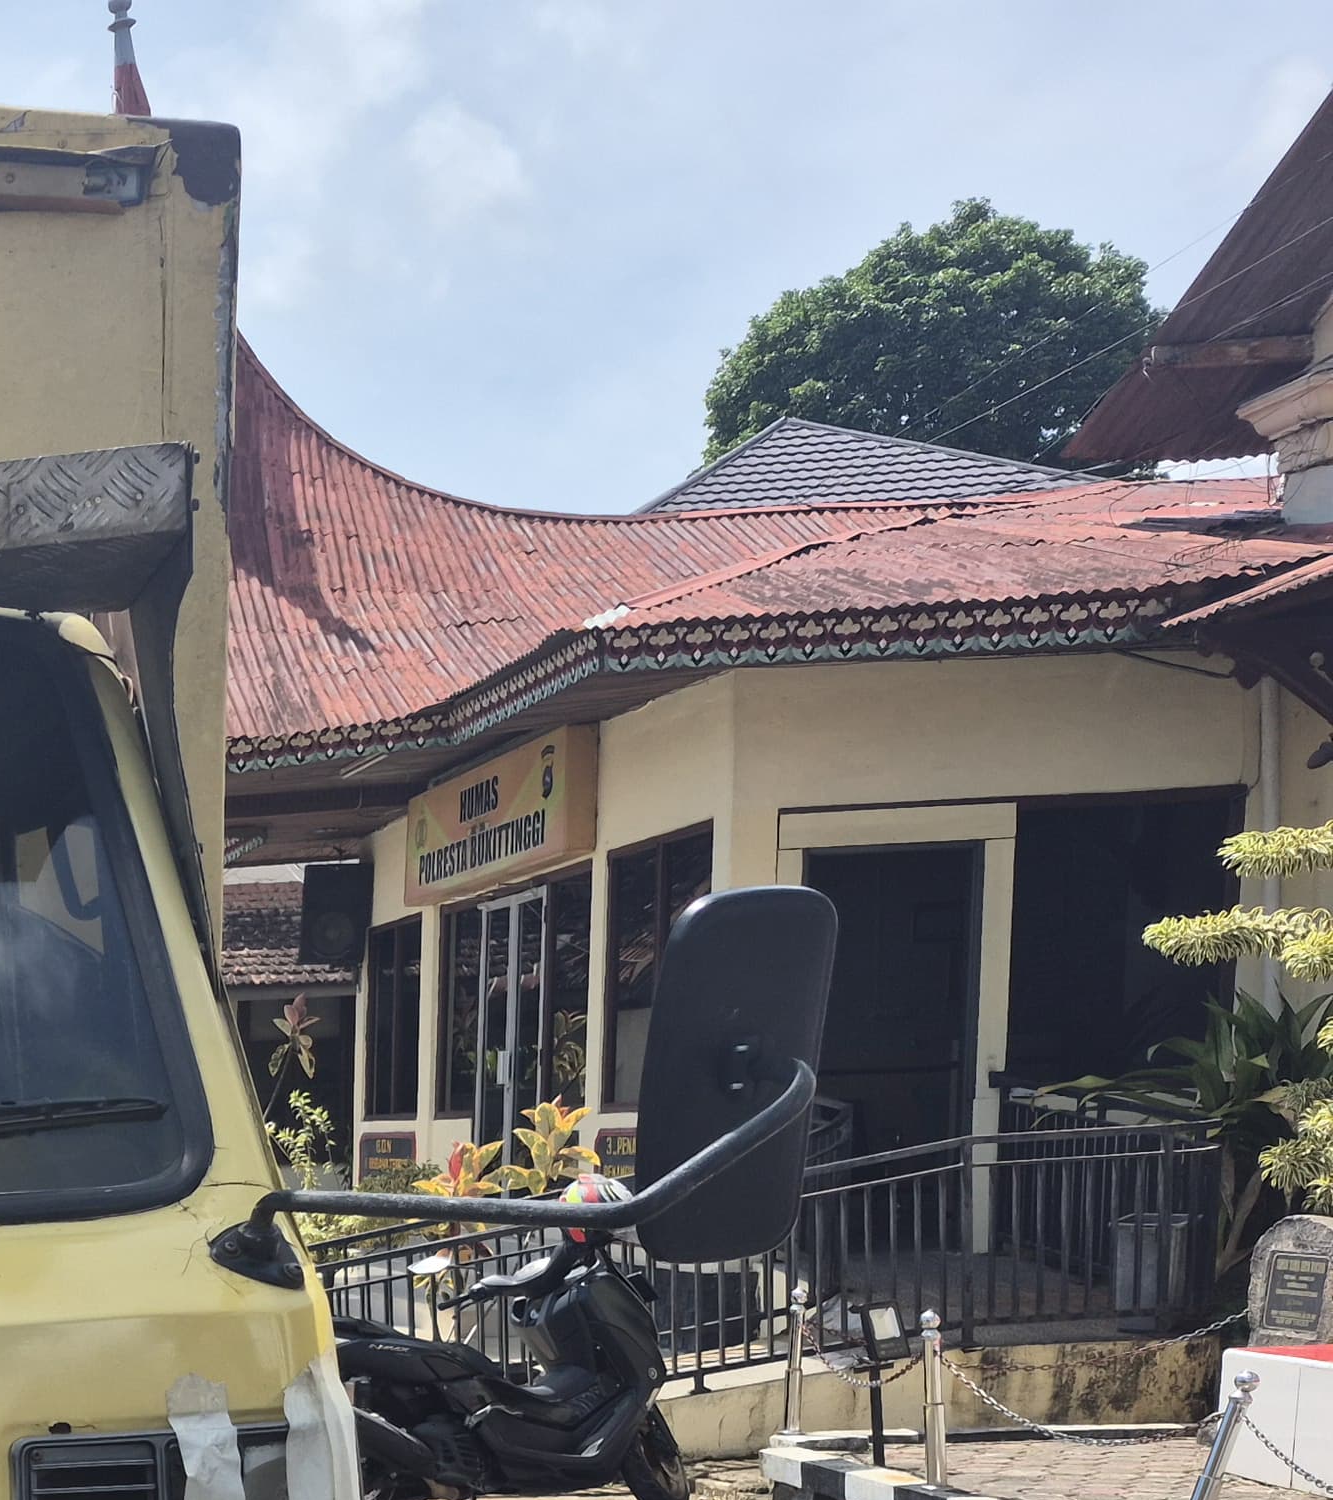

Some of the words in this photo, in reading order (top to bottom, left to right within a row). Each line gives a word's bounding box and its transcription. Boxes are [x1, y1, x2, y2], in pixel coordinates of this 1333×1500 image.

[459, 776, 499, 823] HUMAS
[419, 840, 467, 886] POLRESTA
[470, 808, 545, 868] BUKITTINGGI
